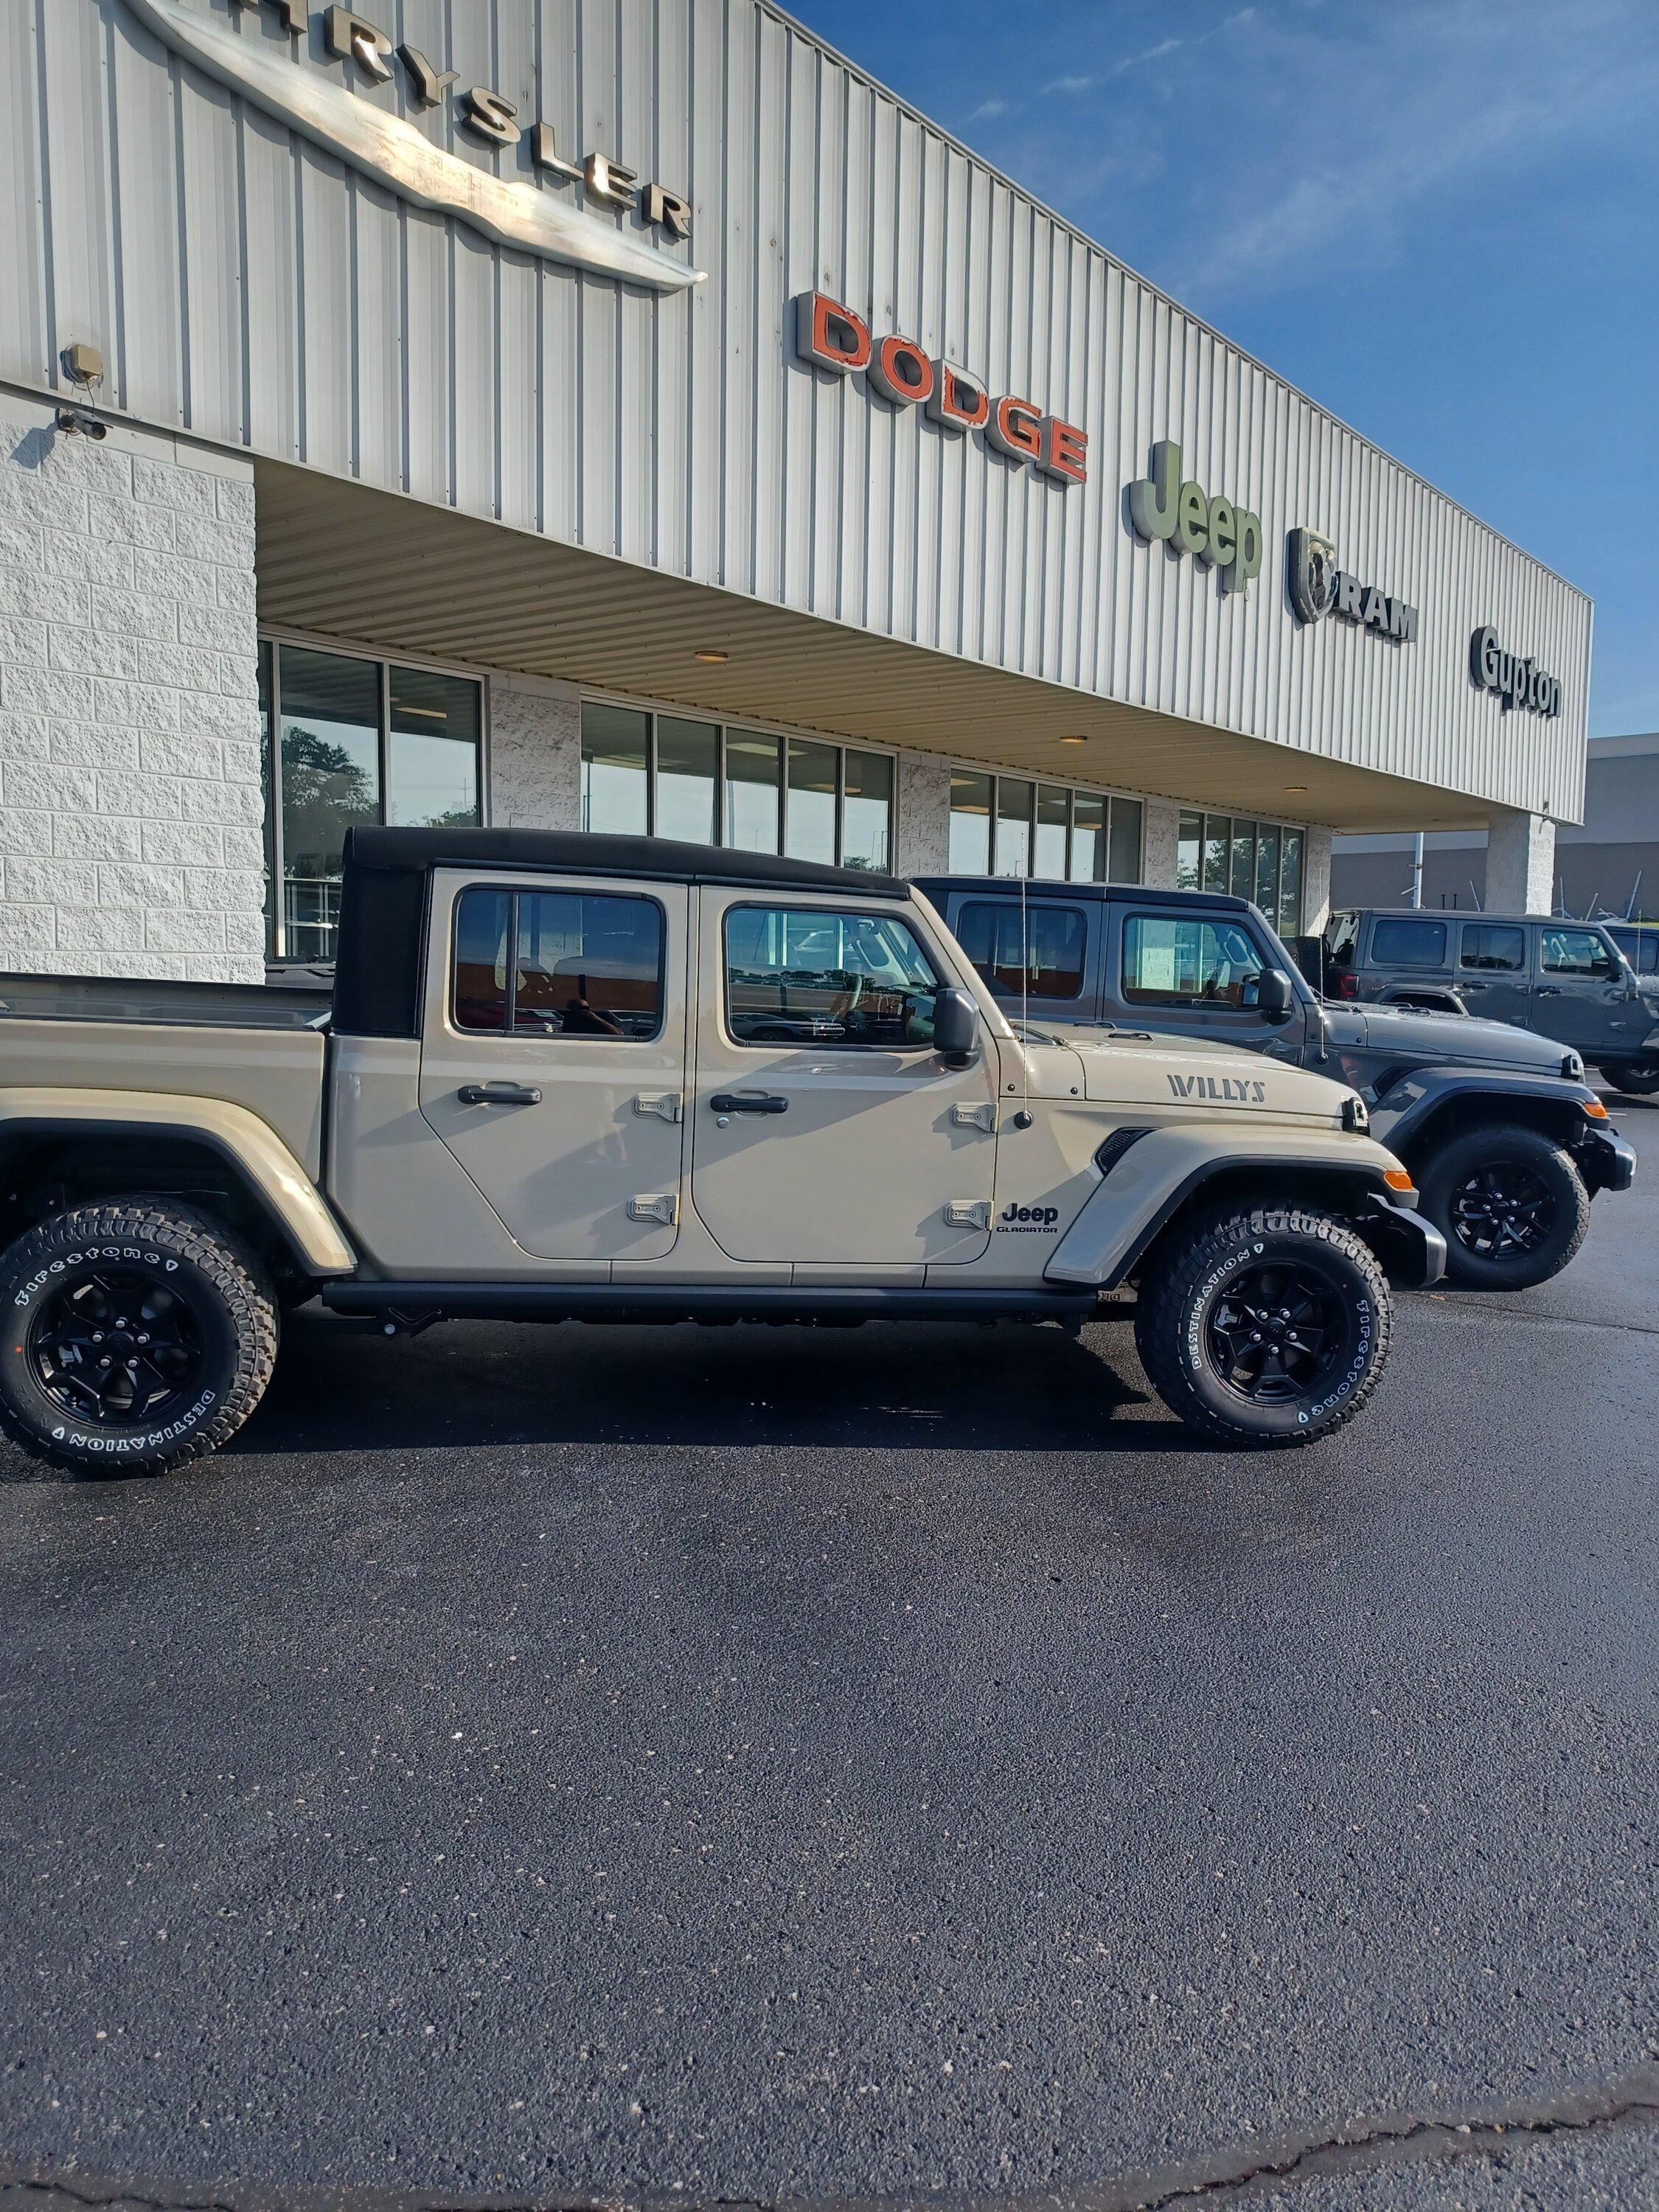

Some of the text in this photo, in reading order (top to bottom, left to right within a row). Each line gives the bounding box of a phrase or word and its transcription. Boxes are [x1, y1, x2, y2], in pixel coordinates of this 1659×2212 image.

[798, 289, 1088, 485] DODGE
[1130, 440, 1262, 593] Jeep
[1333, 571, 1419, 643] RAM
[1471, 625, 1562, 718] Gupton
[1166, 1074, 1266, 1103] WILLYS
[1002, 1203, 1058, 1225] Jeep
[15, 1247, 161, 1307] Firestone
[1188, 1248, 1251, 1370] DESTINATION
[1311, 1300, 1370, 1416] Firestone
[69, 1390, 215, 1451] DESTINATION
